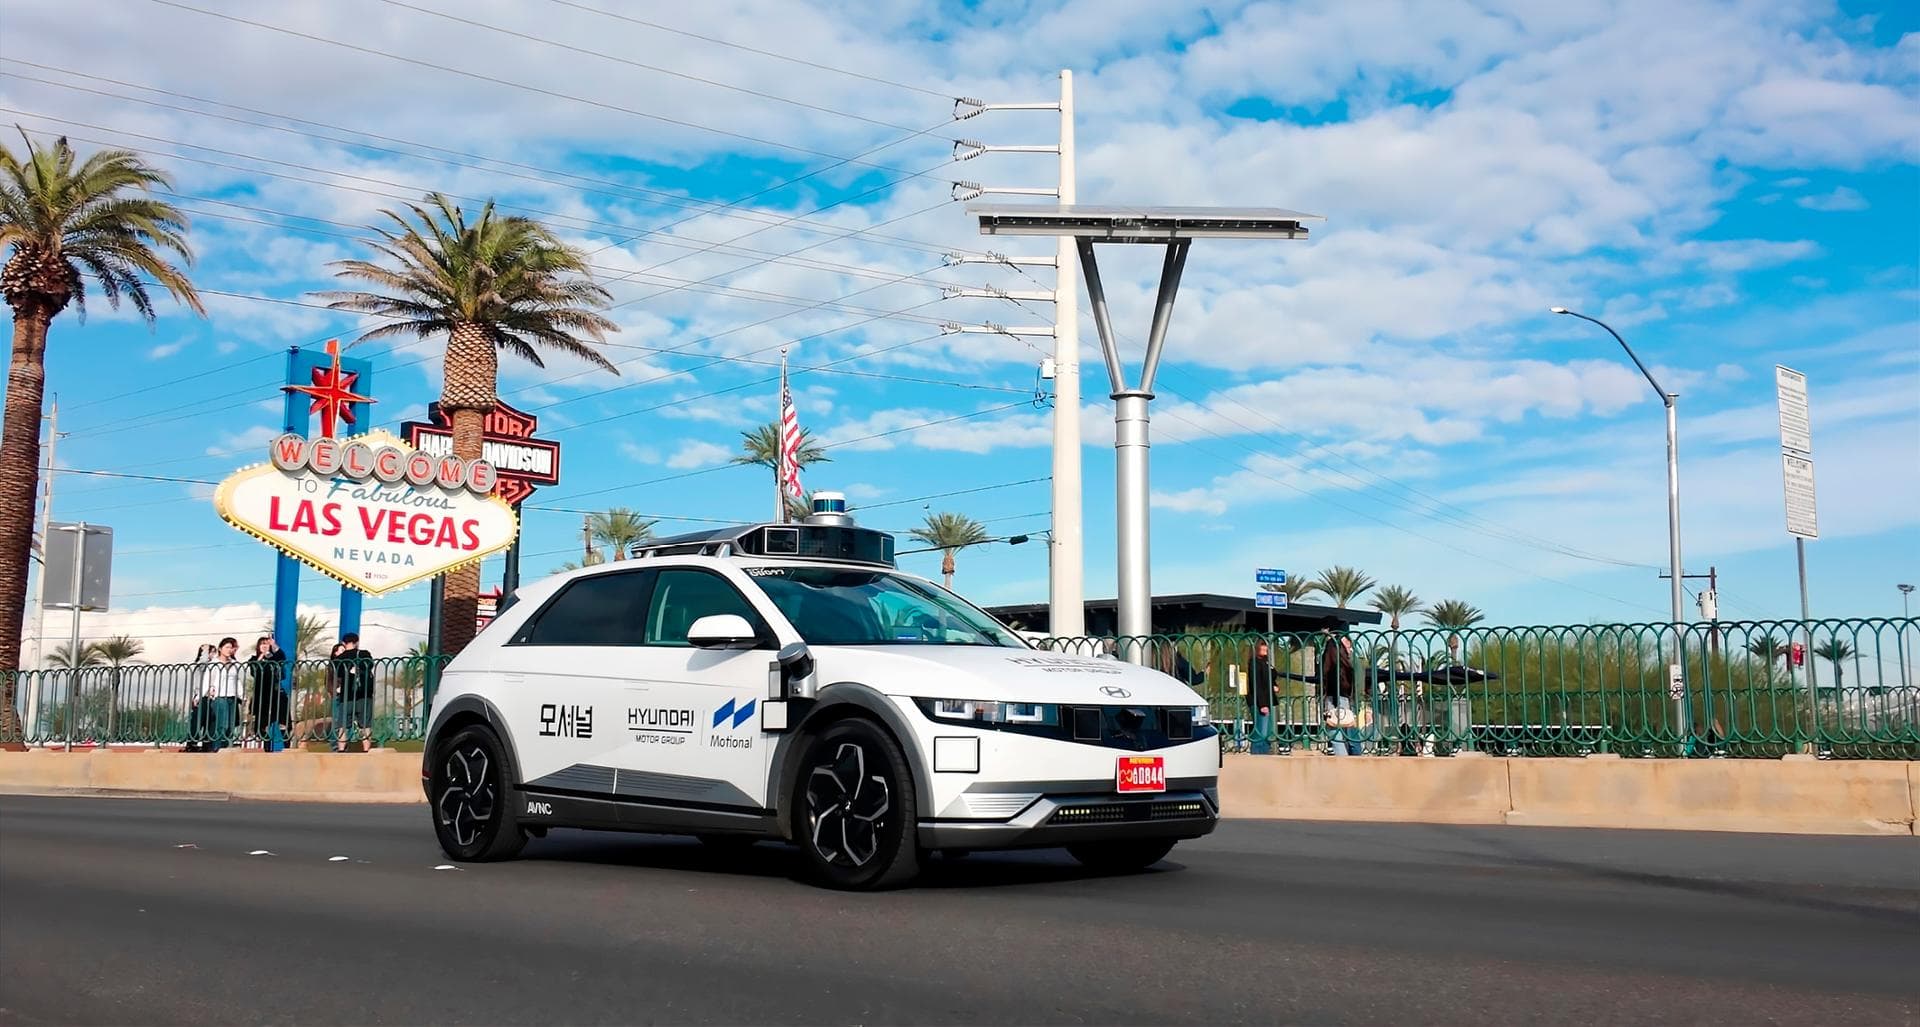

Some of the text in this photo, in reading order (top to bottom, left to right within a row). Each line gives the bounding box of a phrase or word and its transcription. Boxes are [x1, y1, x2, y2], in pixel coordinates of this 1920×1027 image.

[280, 440, 488, 486] WELCOME
[294, 477, 456, 509] TO Fabulous
[269, 496, 480, 551] LAS VEGAS
[334, 547, 415, 566] NEVADA
[539, 704, 593, 738] 모셔널
[628, 708, 694, 726] HYUNDAI
[635, 735, 686, 745] MOTOR GROUP
[710, 735, 753, 749] Motional
